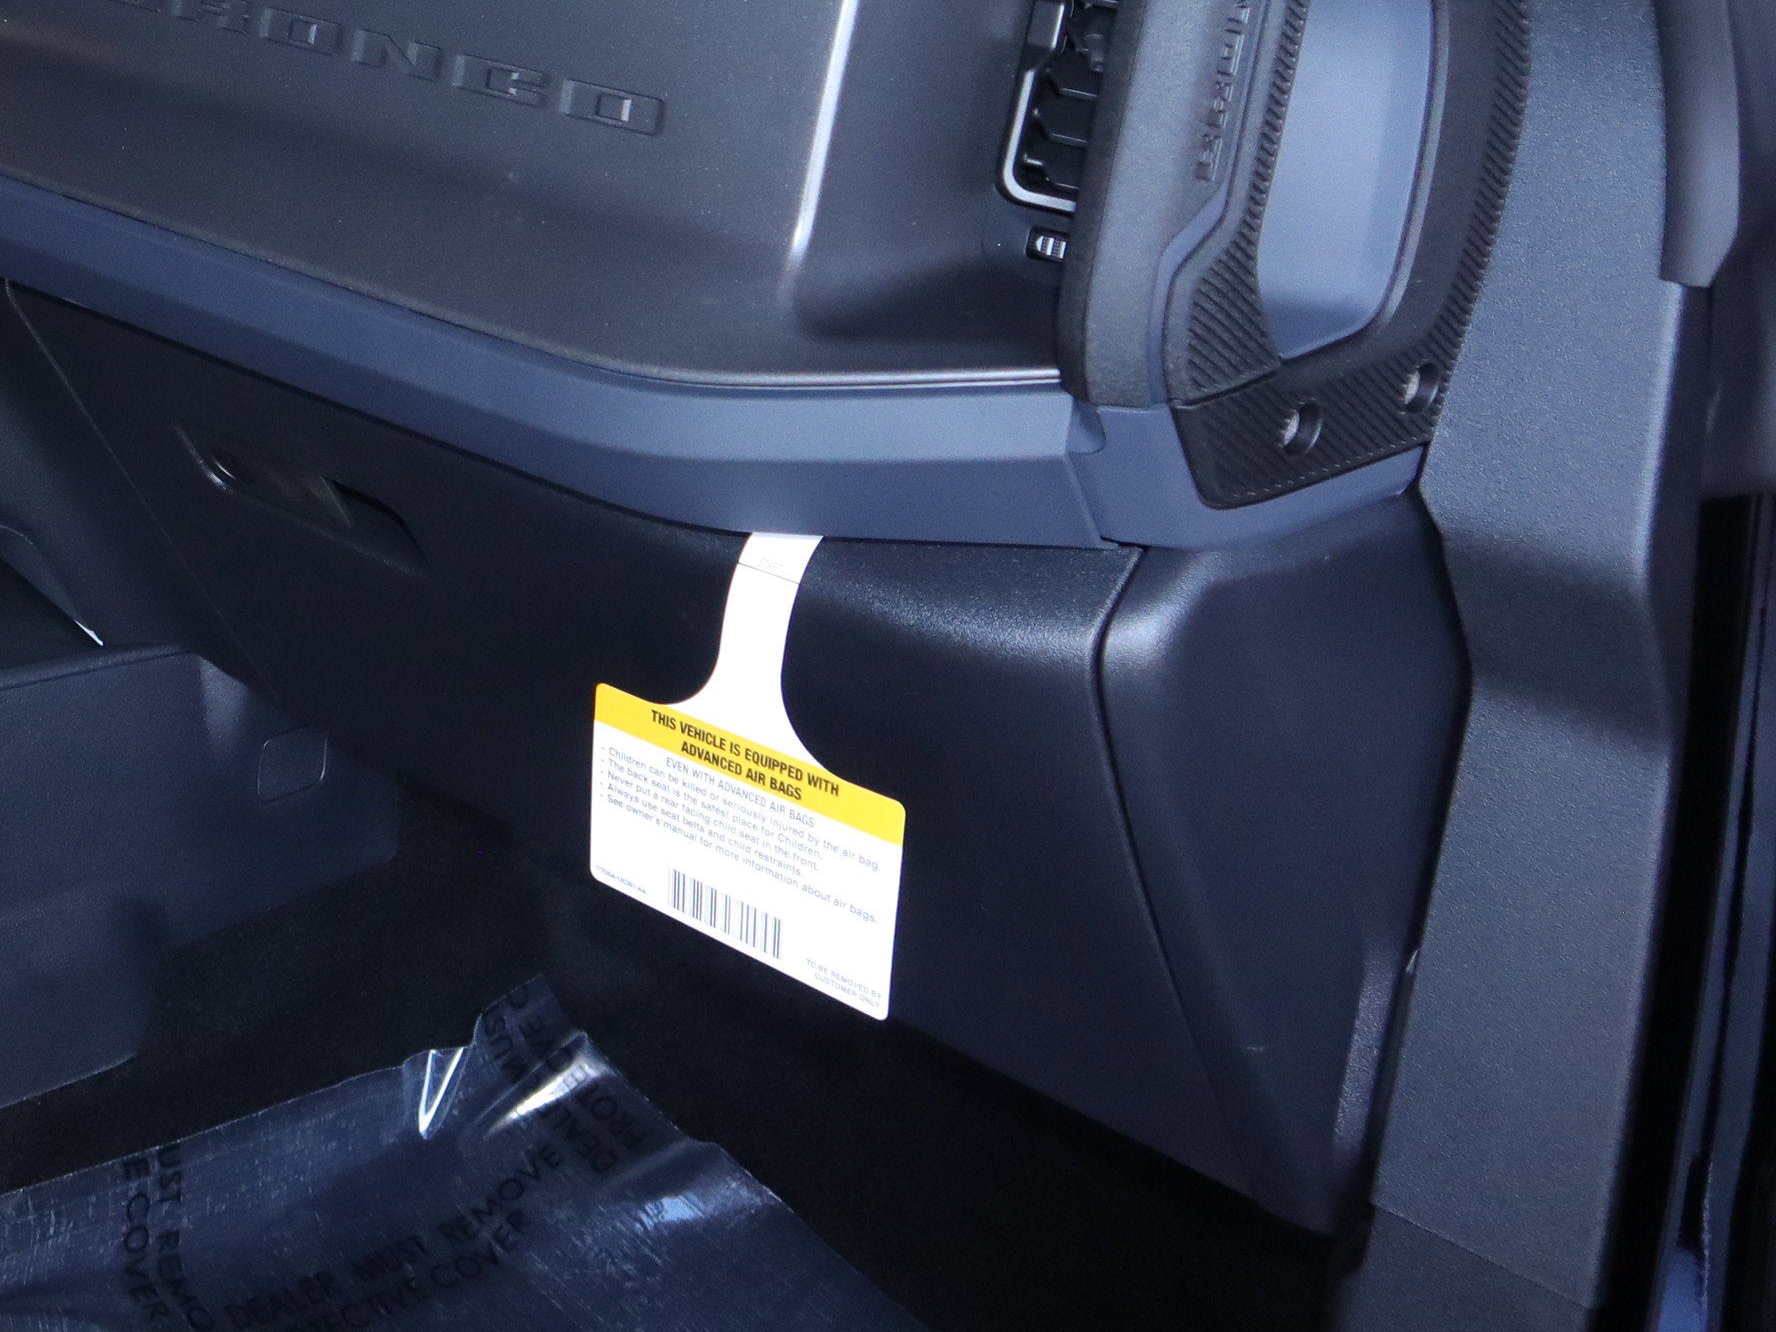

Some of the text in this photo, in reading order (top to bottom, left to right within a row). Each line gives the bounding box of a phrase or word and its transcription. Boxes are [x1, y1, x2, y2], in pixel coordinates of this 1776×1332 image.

[651, 709, 840, 797] THIS VEHICLE IS EQUIPPED WITH
[666, 757, 815, 828] EVEN WITH ADVANCED AIR BAGS
[681, 741, 802, 800] ADVANCED AIR BAGS
[607, 770, 633, 787] Never
[636, 784, 651, 797] put
[660, 796, 679, 809] rear
[682, 803, 710, 825] facing
[713, 819, 737, 834] child
[739, 830, 760, 845] seat
[763, 840, 772, 850] in
[774, 844, 790, 858] the
[607, 783, 639, 803] Always
[642, 800, 658, 811] use
[661, 808, 680, 822] seat
[682, 816, 705, 833] belts
[708, 828, 726, 842] and
[728, 838, 752, 854] child
[608, 758, 625, 773] The
[627, 768, 648, 782] back
[651, 778, 670, 793] seat
[673, 788, 681, 797] is
[683, 792, 698, 804] the
[701, 800, 729, 817] safest
[732, 815, 758, 832] place
[761, 826, 774, 837] for
[608, 747, 646, 769] Children
[649, 766, 665, 779] can
[668, 773, 679, 784] be
[682, 779, 706, 796] killed
[710, 792, 720, 801] or
[722, 798, 767, 823] seriously
[770, 816, 805, 839] injured
[808, 833, 820, 845] by
[823, 840, 839, 853] the
[842, 848, 856, 859] air
[607, 793, 623, 808] See
[663, 820, 698, 840] manual
[700, 836, 713, 848] for
[715, 844, 740, 862] more
[743, 855, 799, 887] information
[801, 883, 831, 903] about
[833, 898, 847, 909] air
[849, 903, 878, 924] bags.
[806, 958, 882, 999] TO BE REMOVED BY
[814, 973, 881, 1008] CUSTOMER ONLY
[436, 1138, 566, 1246] REMOVE
[124, 1193, 170, 1322] COVER
[158, 1146, 215, 1331] UST REMO
[426, 1207, 533, 1292] COVER
